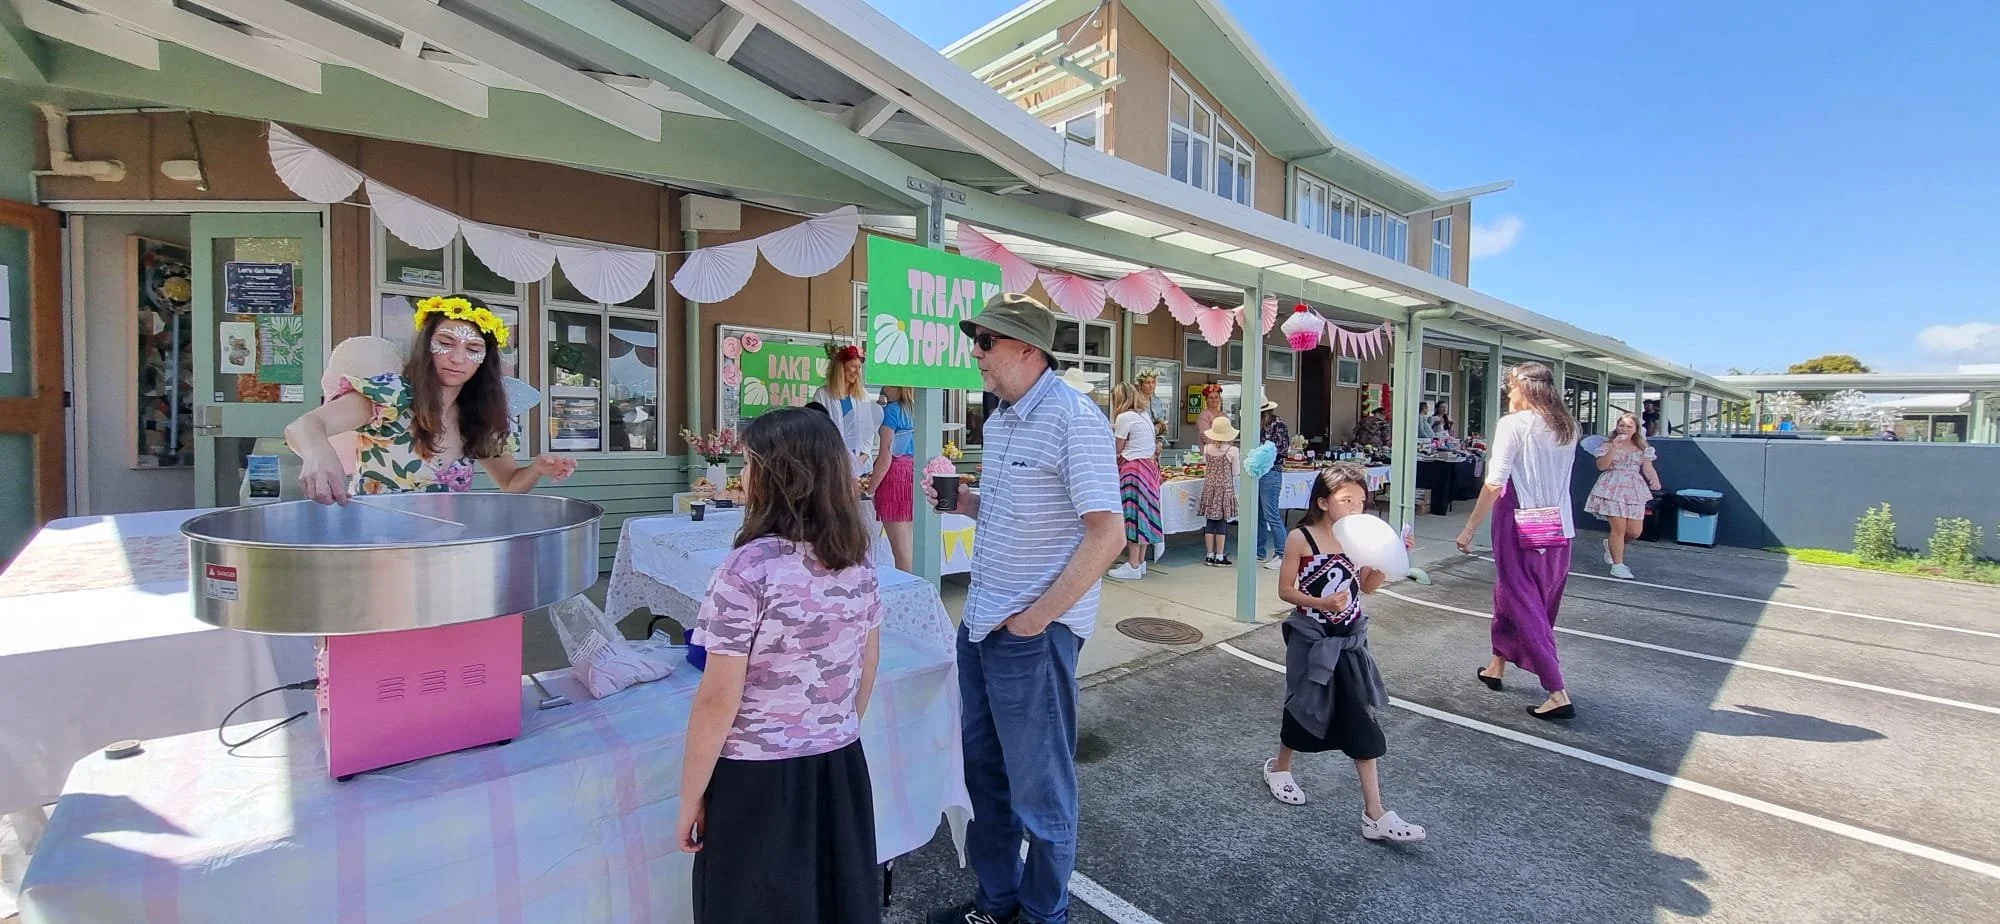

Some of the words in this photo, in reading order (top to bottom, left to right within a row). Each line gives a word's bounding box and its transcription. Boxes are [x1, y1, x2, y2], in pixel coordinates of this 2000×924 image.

[908, 268, 976, 320] TREAT
[745, 336, 758, 347] $2
[910, 318, 972, 369] TOPIA
[768, 354, 810, 381] BAKE
[769, 382, 808, 408] SALE
